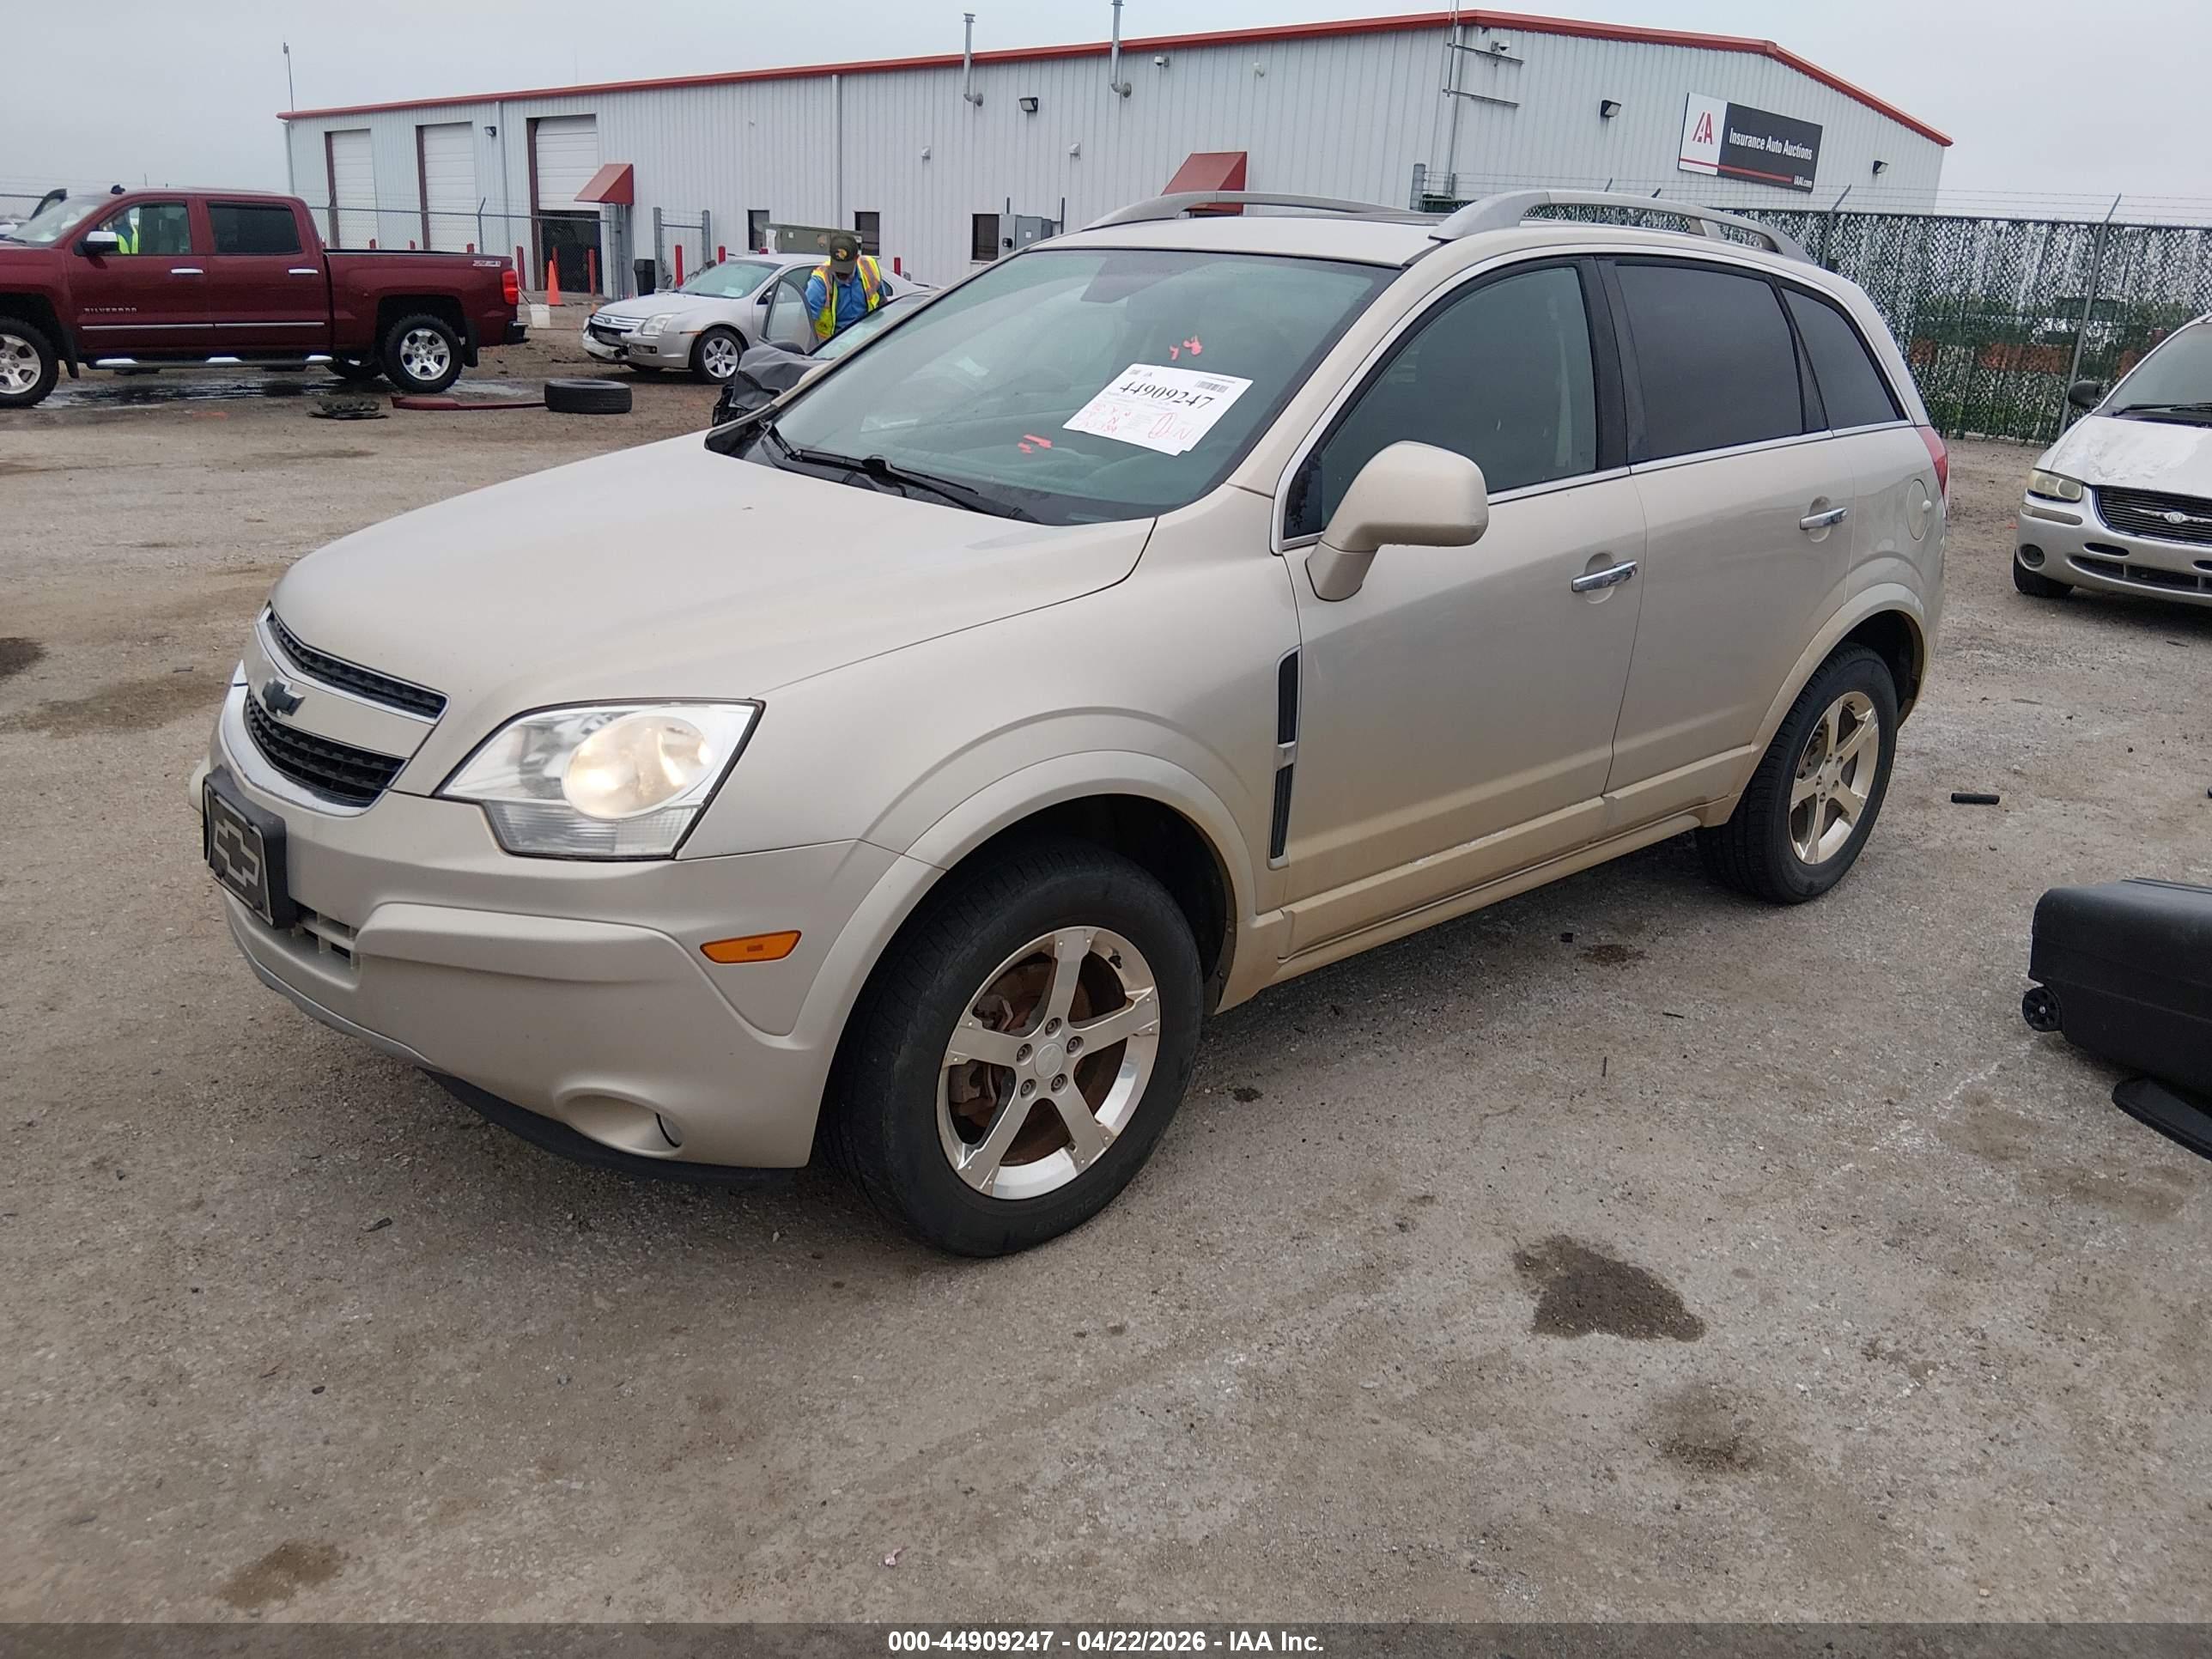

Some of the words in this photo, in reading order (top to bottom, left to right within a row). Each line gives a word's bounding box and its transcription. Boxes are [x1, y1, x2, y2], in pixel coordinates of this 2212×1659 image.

[1729, 127, 1765, 151] Insurance
[1765, 136, 1784, 154] Auto
[1783, 139, 1813, 161] Auctions
[1119, 380, 1216, 410] 44909247
